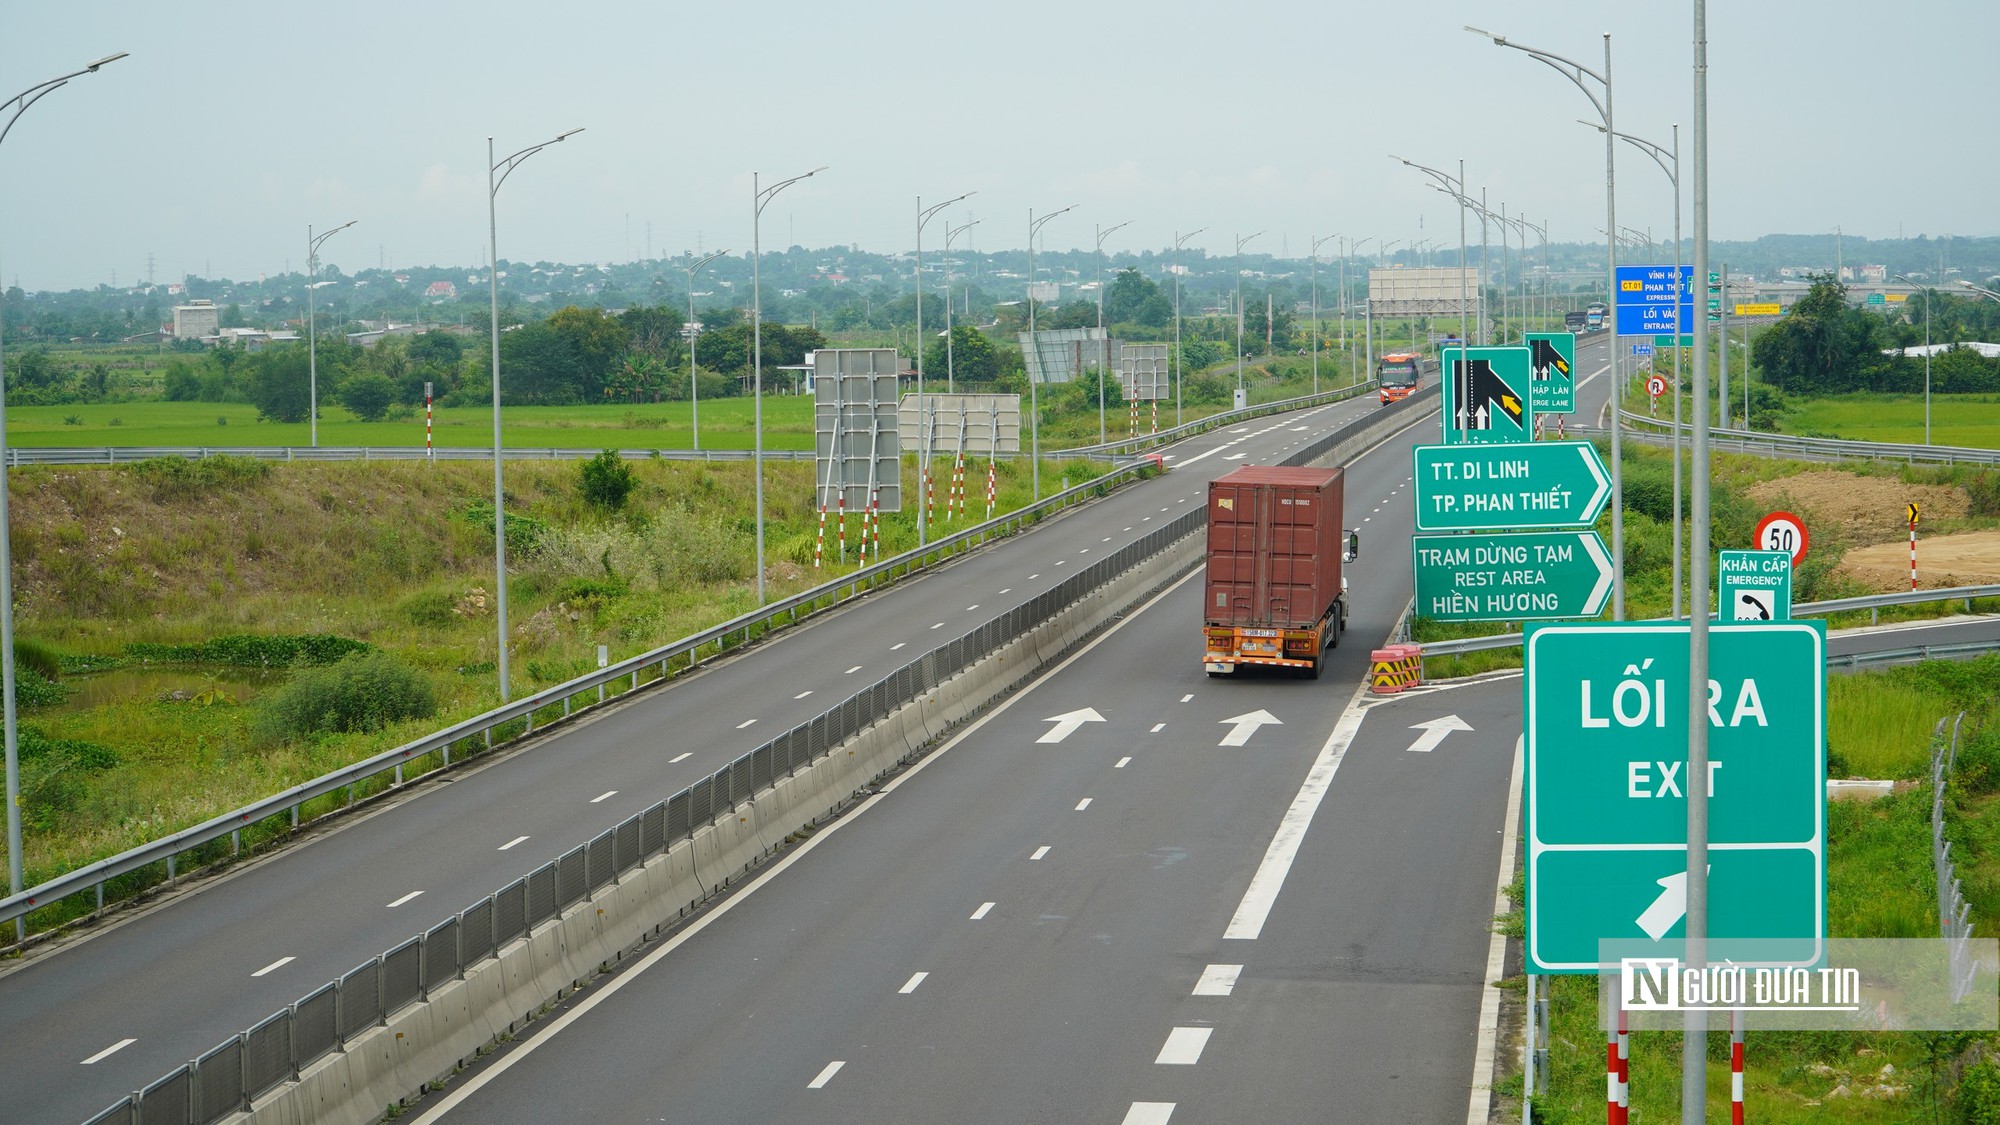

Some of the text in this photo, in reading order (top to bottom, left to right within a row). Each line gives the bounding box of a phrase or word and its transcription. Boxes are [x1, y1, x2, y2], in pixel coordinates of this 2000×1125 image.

[1648, 270, 1682, 279] VĨNH HO
[1666, 281, 1685, 291] THT
[1644, 306, 1657, 318] LỐI
[1533, 384, 1568, 396] HẬP LÀN
[1431, 460, 1529, 480] TT. DI LINH
[1432, 484, 1572, 512] TP. PHAN THIẾT
[1770, 528, 1793, 551] 50
[1418, 542, 1572, 569] TRẠM DỪNG TẠM
[1722, 554, 1788, 572] KHẨN CẤP
[1455, 570, 1546, 586] REST AREA
[1726, 575, 1783, 586] EMERGENCY
[1432, 589, 1558, 614] HIỀN HƯƠNG
[1581, 658, 1666, 728] LỐI
[1628, 761, 1722, 798] EXT
